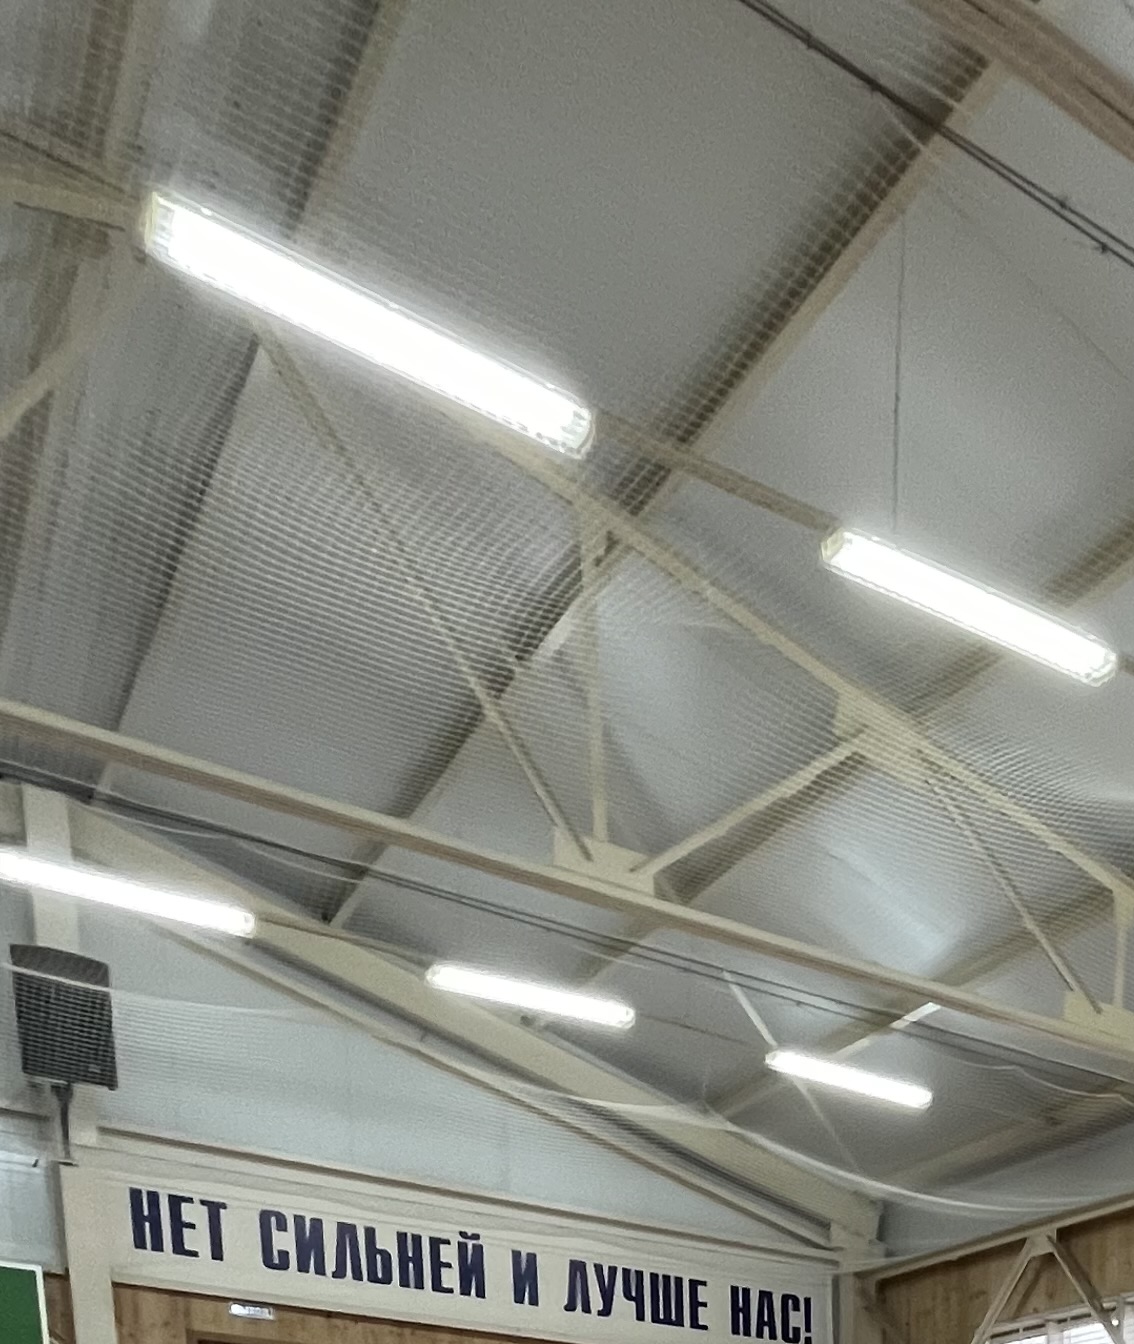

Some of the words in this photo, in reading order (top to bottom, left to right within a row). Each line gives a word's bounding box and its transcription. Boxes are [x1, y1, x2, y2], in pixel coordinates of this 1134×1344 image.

[129, 1187, 228, 1262] НЕТ
[258, 1209, 488, 1300] СИЛЬНЕЙ
[511, 1249, 539, 1307] И
[563, 1259, 709, 1331] ЛУЧШЕ
